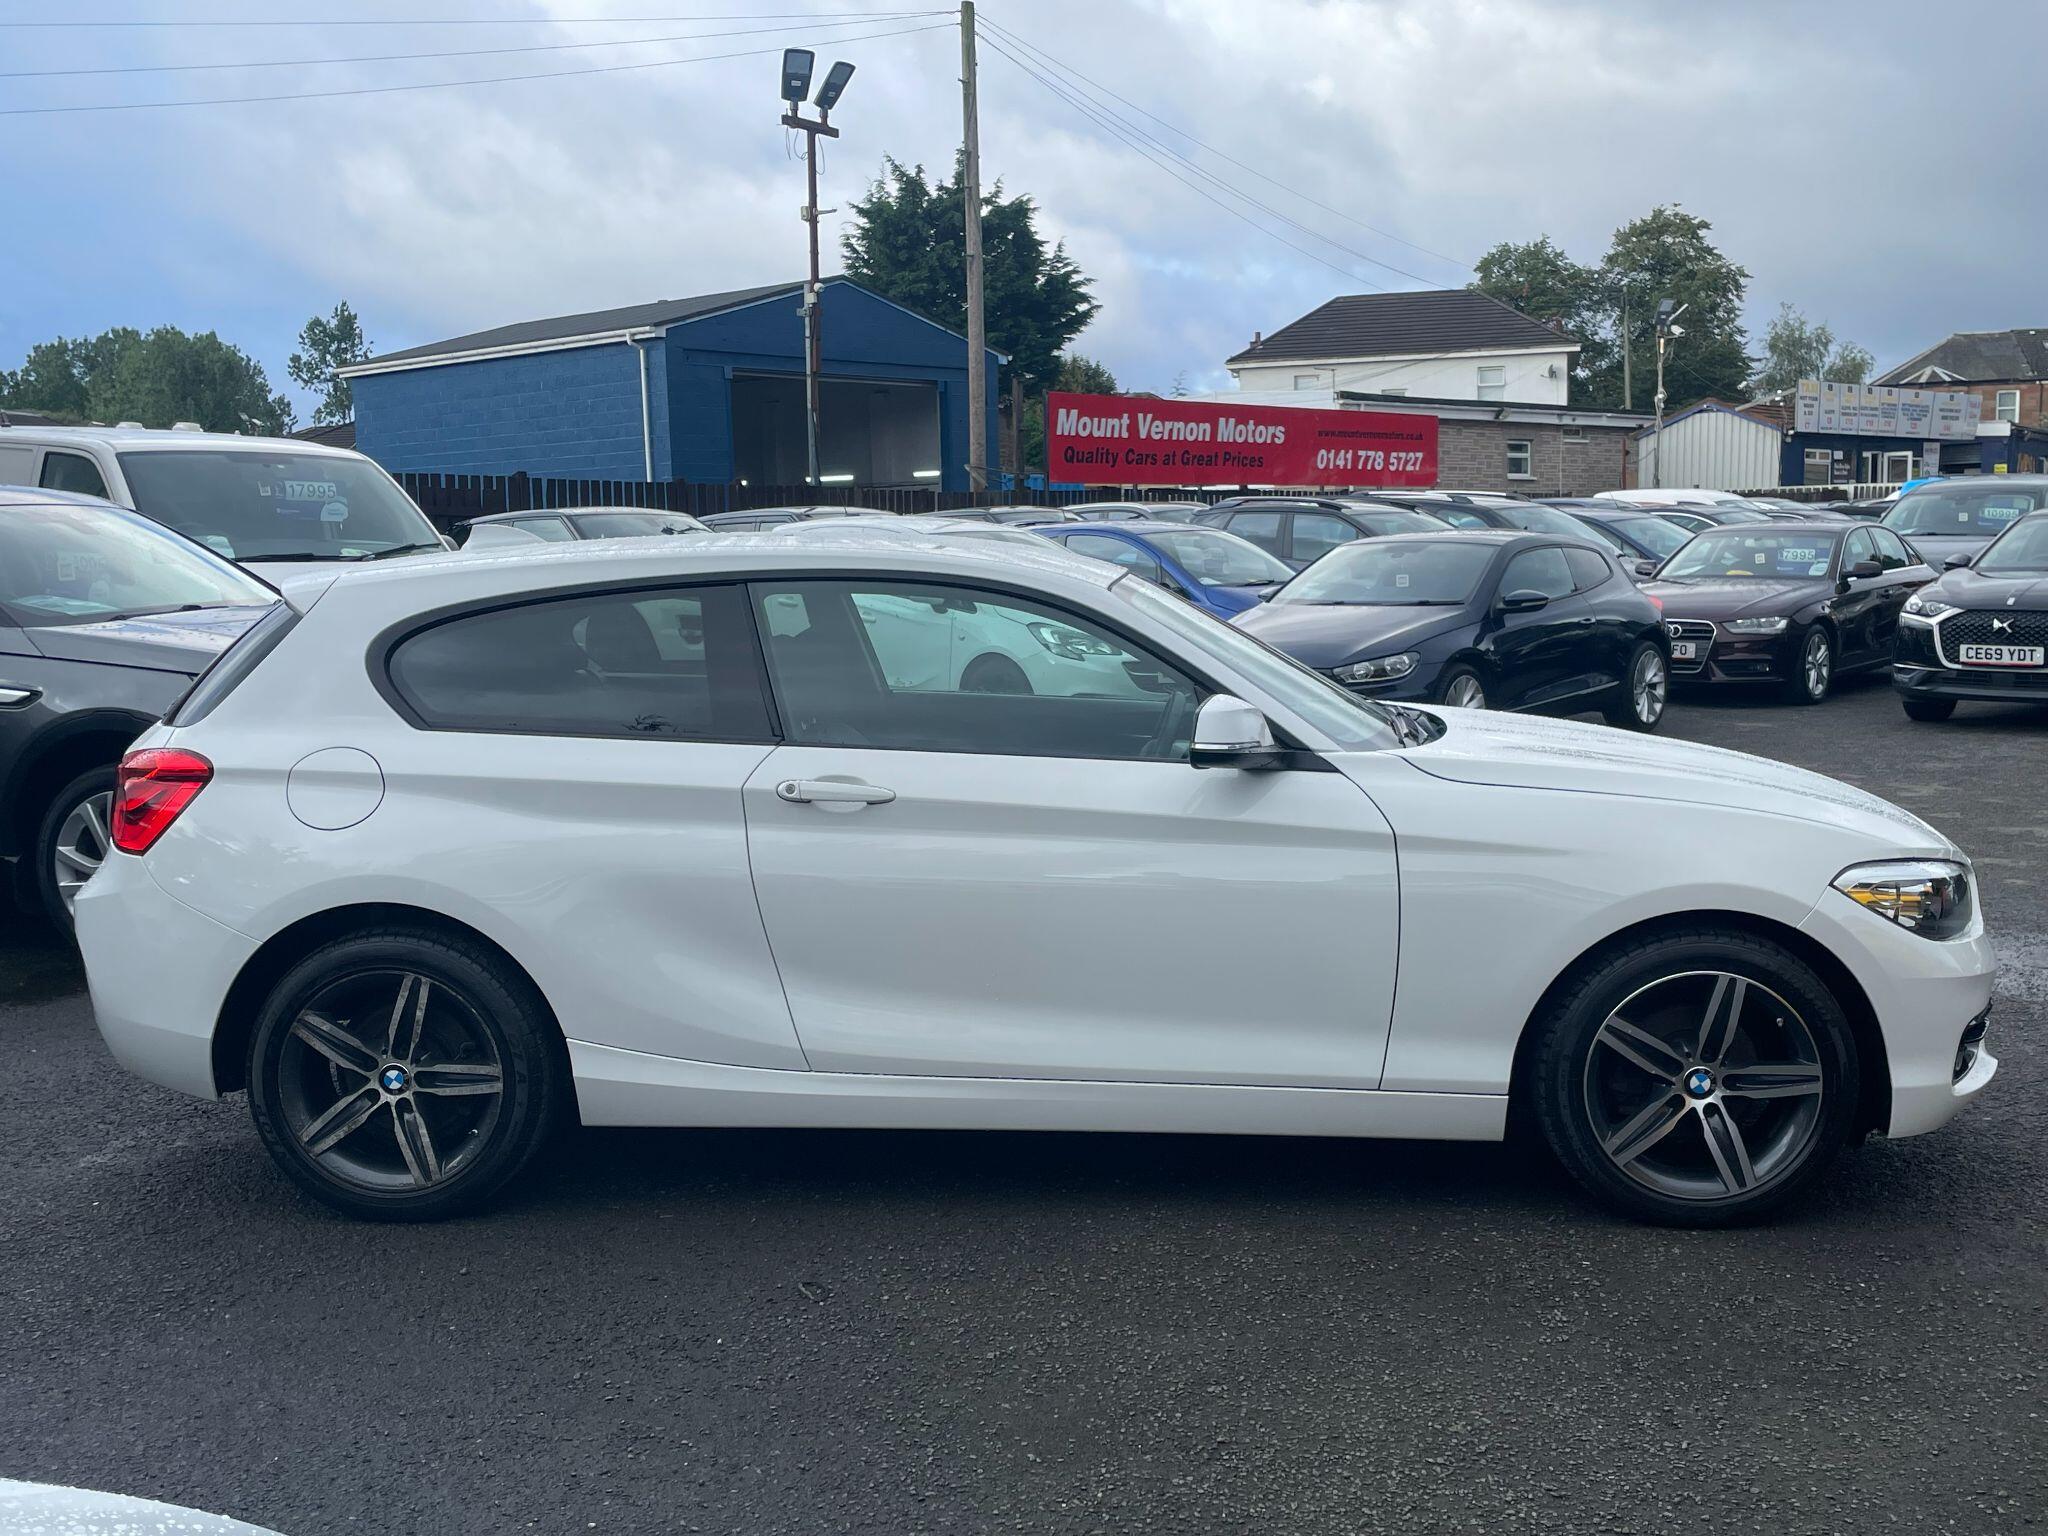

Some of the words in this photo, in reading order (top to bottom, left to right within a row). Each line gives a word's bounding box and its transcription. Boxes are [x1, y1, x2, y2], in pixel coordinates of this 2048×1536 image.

[1056, 408, 1130, 439] Mount
[1137, 413, 1211, 442] Vernon
[1217, 417, 1286, 445] Motors
[1063, 445, 1119, 468] Quality
[1124, 447, 1159, 466] Cars
[1162, 450, 1177, 467] at
[1181, 450, 1219, 467] Great
[1222, 451, 1264, 468] Prices
[1316, 449, 1353, 470] 0141
[1357, 450, 1385, 471] 778
[1388, 452, 1424, 472] 5727
[1965, 646, 2004, 661] CE69
[2007, 648, 2037, 662] YDT
